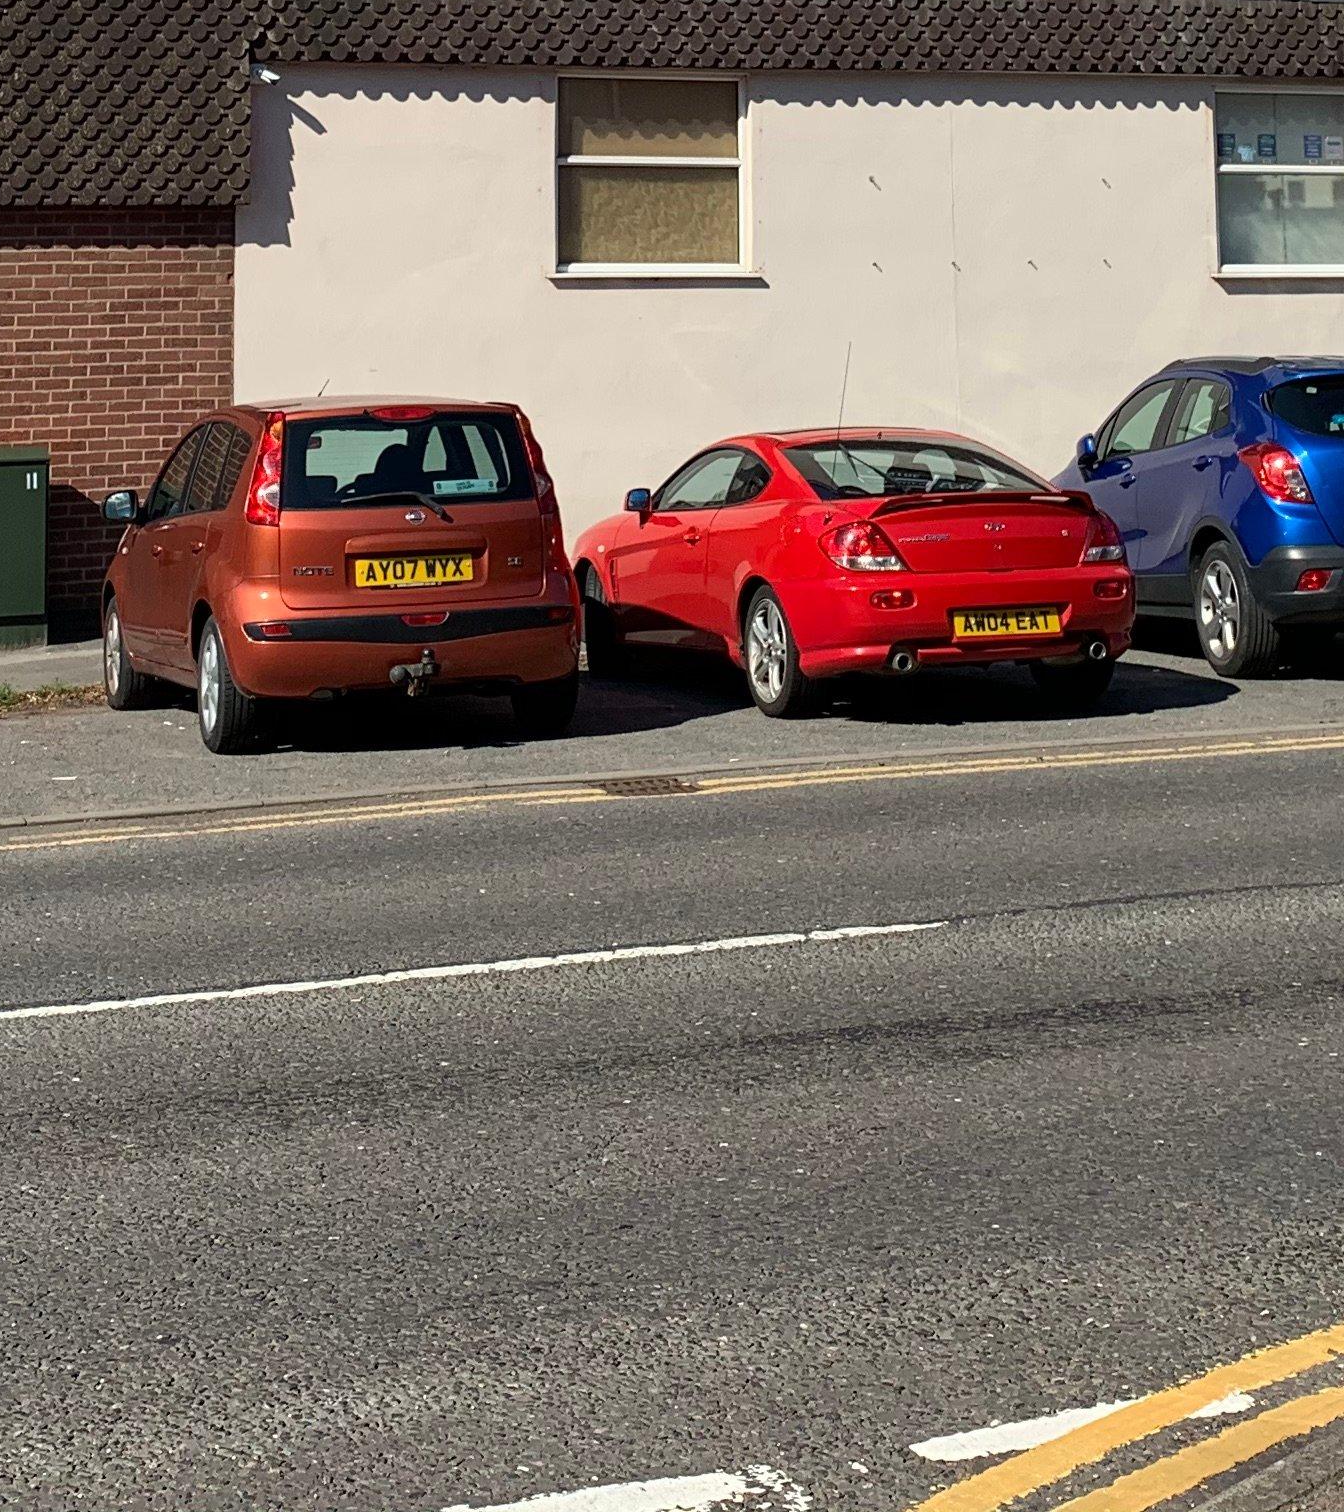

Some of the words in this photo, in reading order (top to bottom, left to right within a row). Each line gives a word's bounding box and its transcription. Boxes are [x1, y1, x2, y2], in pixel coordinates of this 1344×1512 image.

[365, 560, 418, 582] AY07
[425, 557, 464, 579] WYX
[963, 611, 1011, 633] AW04
[1015, 610, 1051, 631] EAT
